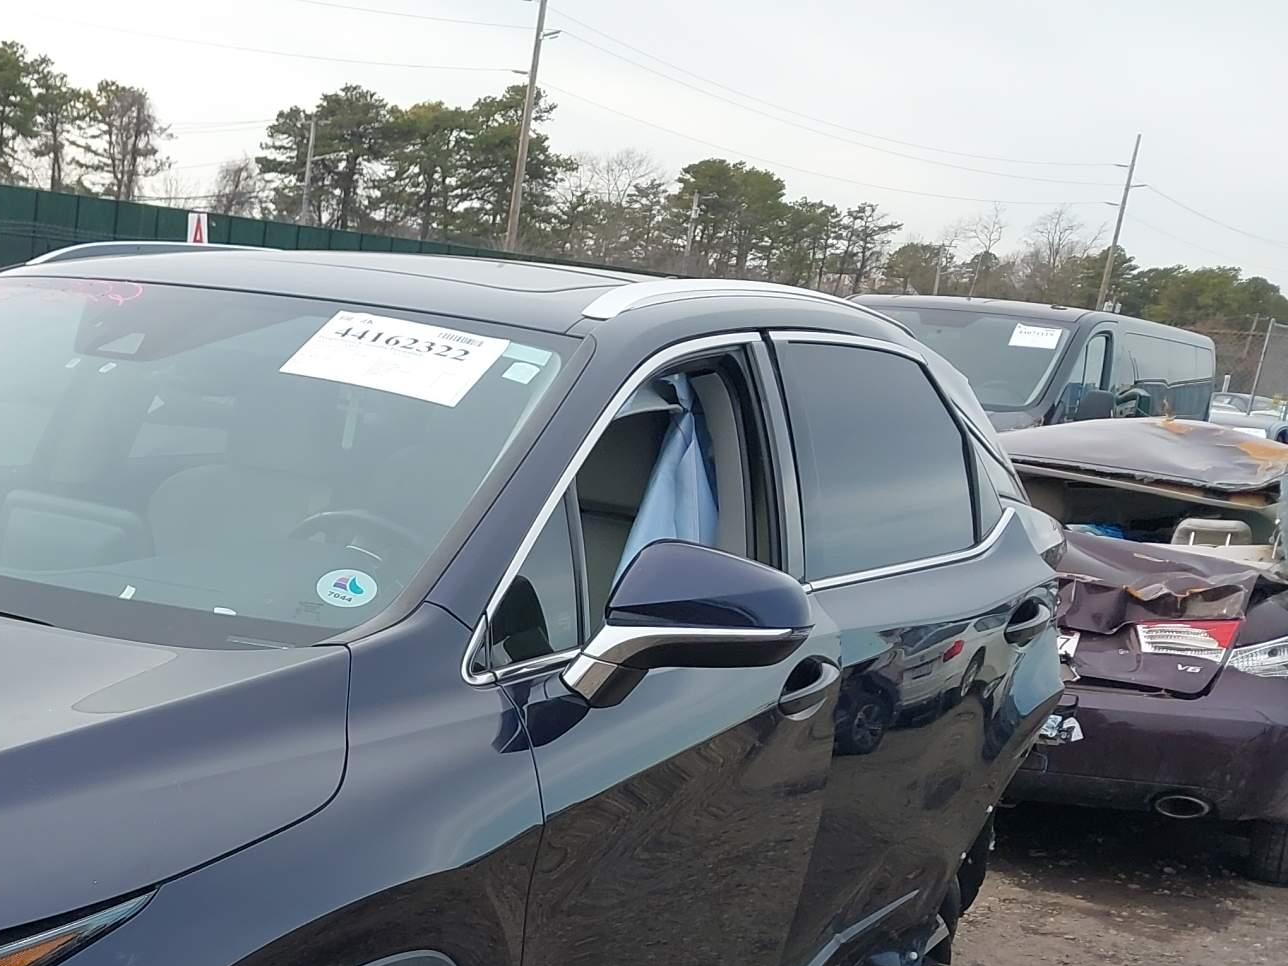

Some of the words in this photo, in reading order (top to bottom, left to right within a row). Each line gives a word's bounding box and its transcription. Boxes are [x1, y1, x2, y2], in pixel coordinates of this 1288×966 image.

[335, 326, 471, 362] 44162322
[327, 590, 353, 603] 7044
[1177, 663, 1202, 673] V6
